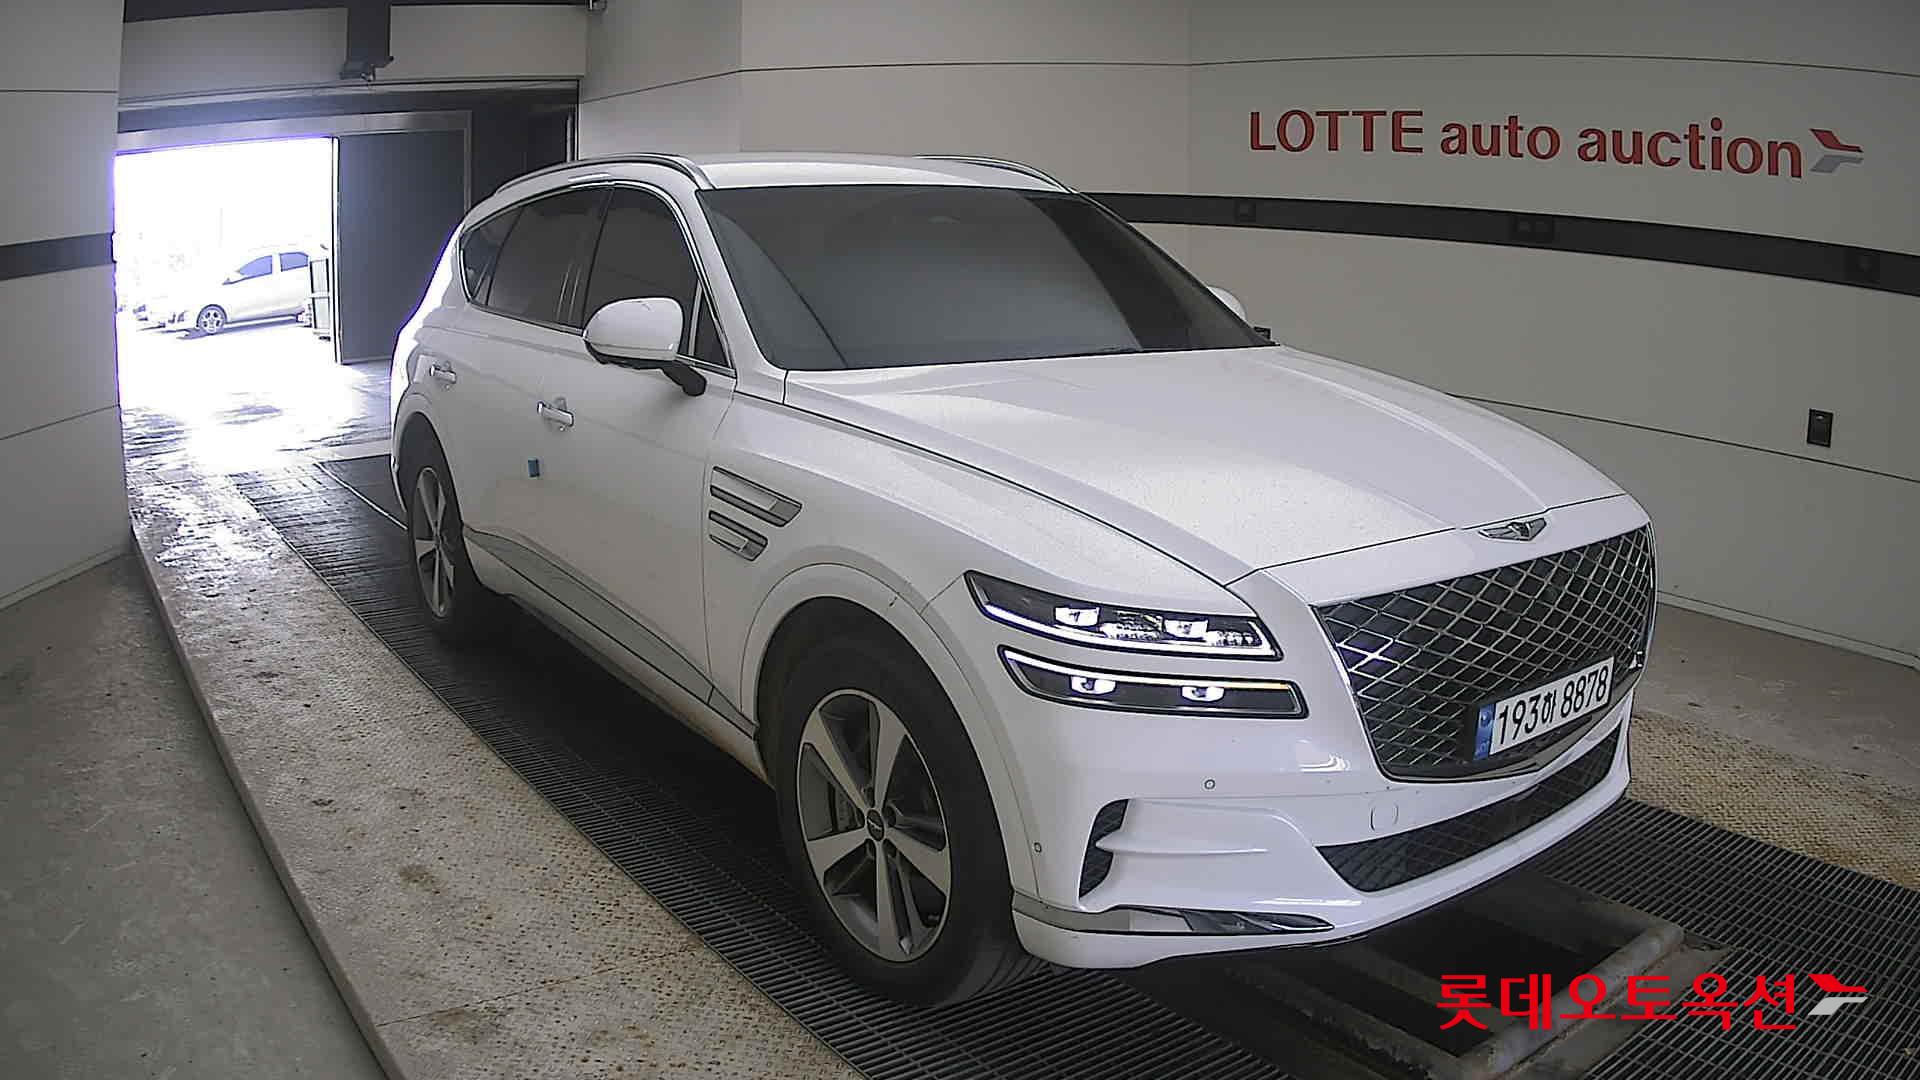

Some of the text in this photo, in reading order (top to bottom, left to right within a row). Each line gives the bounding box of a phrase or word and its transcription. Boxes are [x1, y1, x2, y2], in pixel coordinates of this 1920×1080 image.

[1249, 110, 1803, 178] LOTTE auto auction
[1499, 665, 1609, 745] 193하 8878
